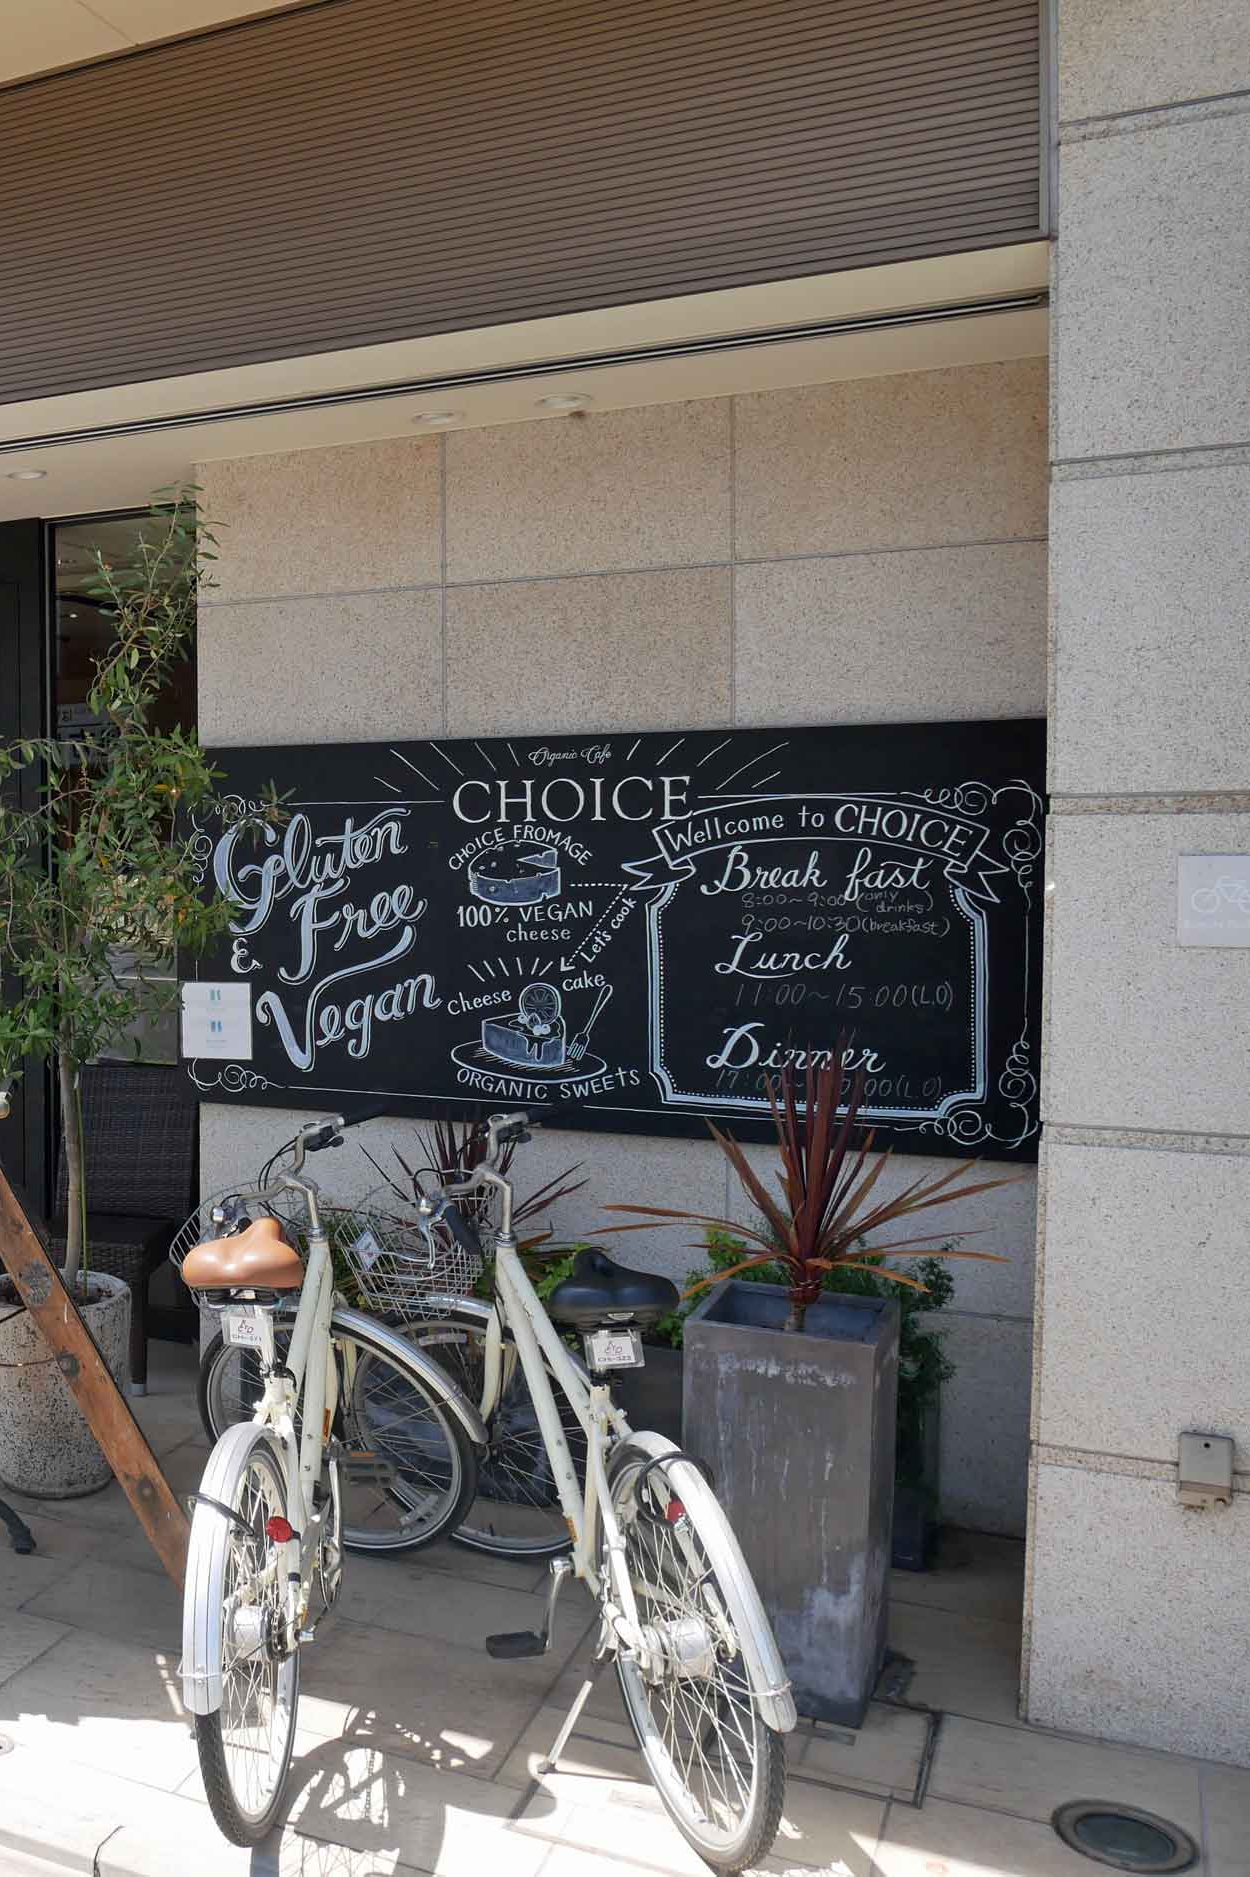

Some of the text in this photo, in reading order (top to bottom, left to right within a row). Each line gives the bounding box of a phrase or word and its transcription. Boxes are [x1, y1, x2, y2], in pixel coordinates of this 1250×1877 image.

[528, 747, 578, 767] Organic
[452, 775, 693, 824] CHOICE
[448, 824, 593, 870] CHOICE FROMAGE
[664, 803, 974, 857] Wellcome to CHOICE
[213, 808, 411, 936] Gluten
[700, 845, 934, 902] Break fast
[278, 876, 428, 985] Free
[456, 900, 593, 928] 100% VEGAN
[506, 923, 572, 942] cheese
[610, 897, 637, 930] cook
[230, 937, 263, 973] &
[714, 933, 853, 979] Lunch
[255, 924, 444, 1072] Vegan
[562, 970, 606, 992] cake
[456, 1067, 548, 1099] ORGANIC
